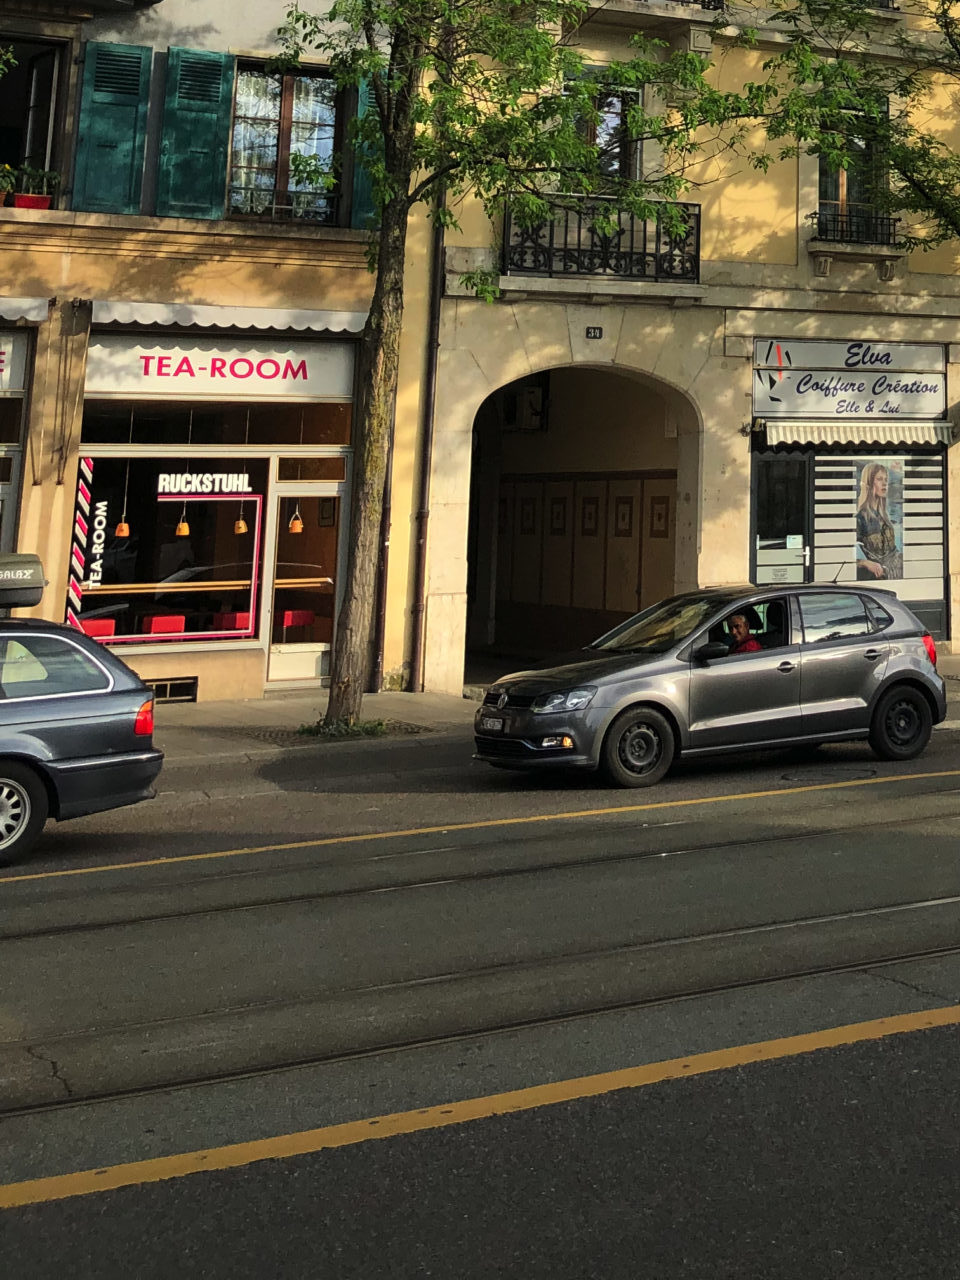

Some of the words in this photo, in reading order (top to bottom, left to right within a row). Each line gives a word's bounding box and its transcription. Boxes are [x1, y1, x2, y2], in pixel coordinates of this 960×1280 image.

[844, 342, 892, 368] Elva
[139, 355, 309, 380] TEA-ROOM
[796, 373, 866, 396] Coiffure
[871, 375, 940, 396] Création
[835, 400, 861, 414] Elle
[864, 400, 875, 413] &
[878, 401, 900, 414] Lui
[158, 473, 252, 493] RUCKSTUHL
[89, 501, 108, 589] TEA-ROOM
